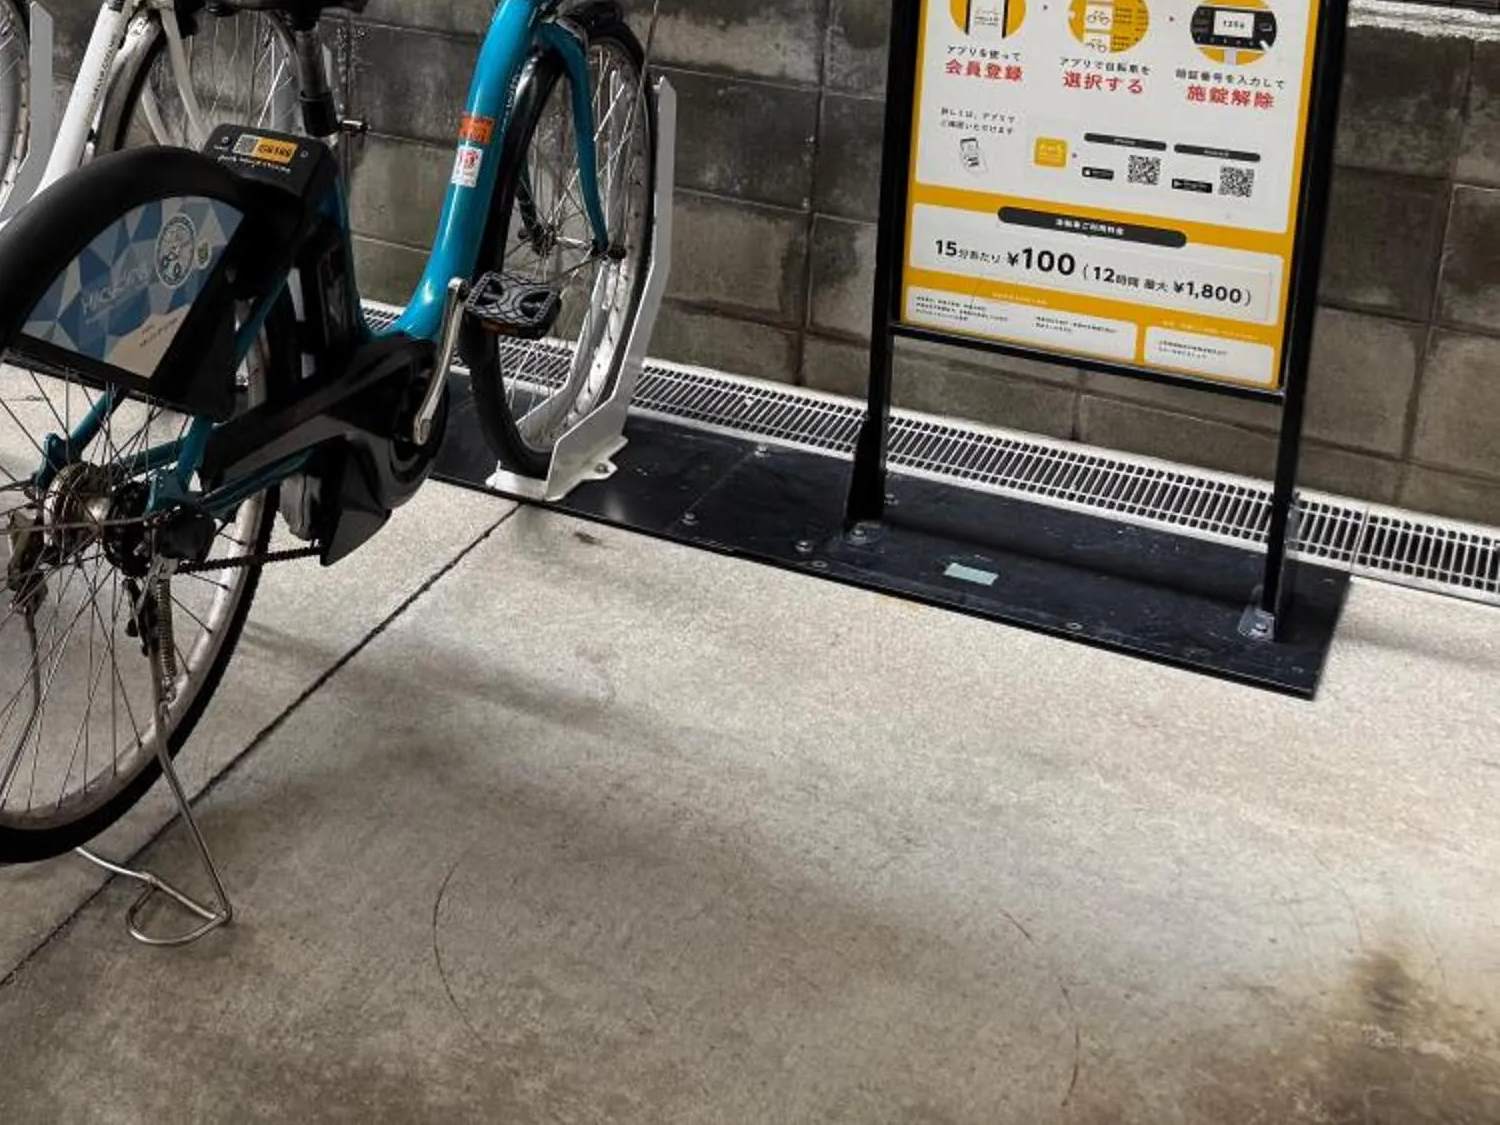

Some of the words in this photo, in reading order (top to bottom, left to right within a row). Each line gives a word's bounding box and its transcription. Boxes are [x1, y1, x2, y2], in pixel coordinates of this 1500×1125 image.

[947, 45, 1022, 62] アプリを使って
[945, 58, 1023, 82] 会員登録
[1059, 57, 1151, 76] アプリで自転車を
[1063, 70, 1144, 94] 選択する
[1186, 83, 1276, 109] 施錠解除
[935, 239, 1001, 265] 15分あたり
[1006, 246, 1076, 277] ¥100
[1144, 278, 1169, 293] 最大
